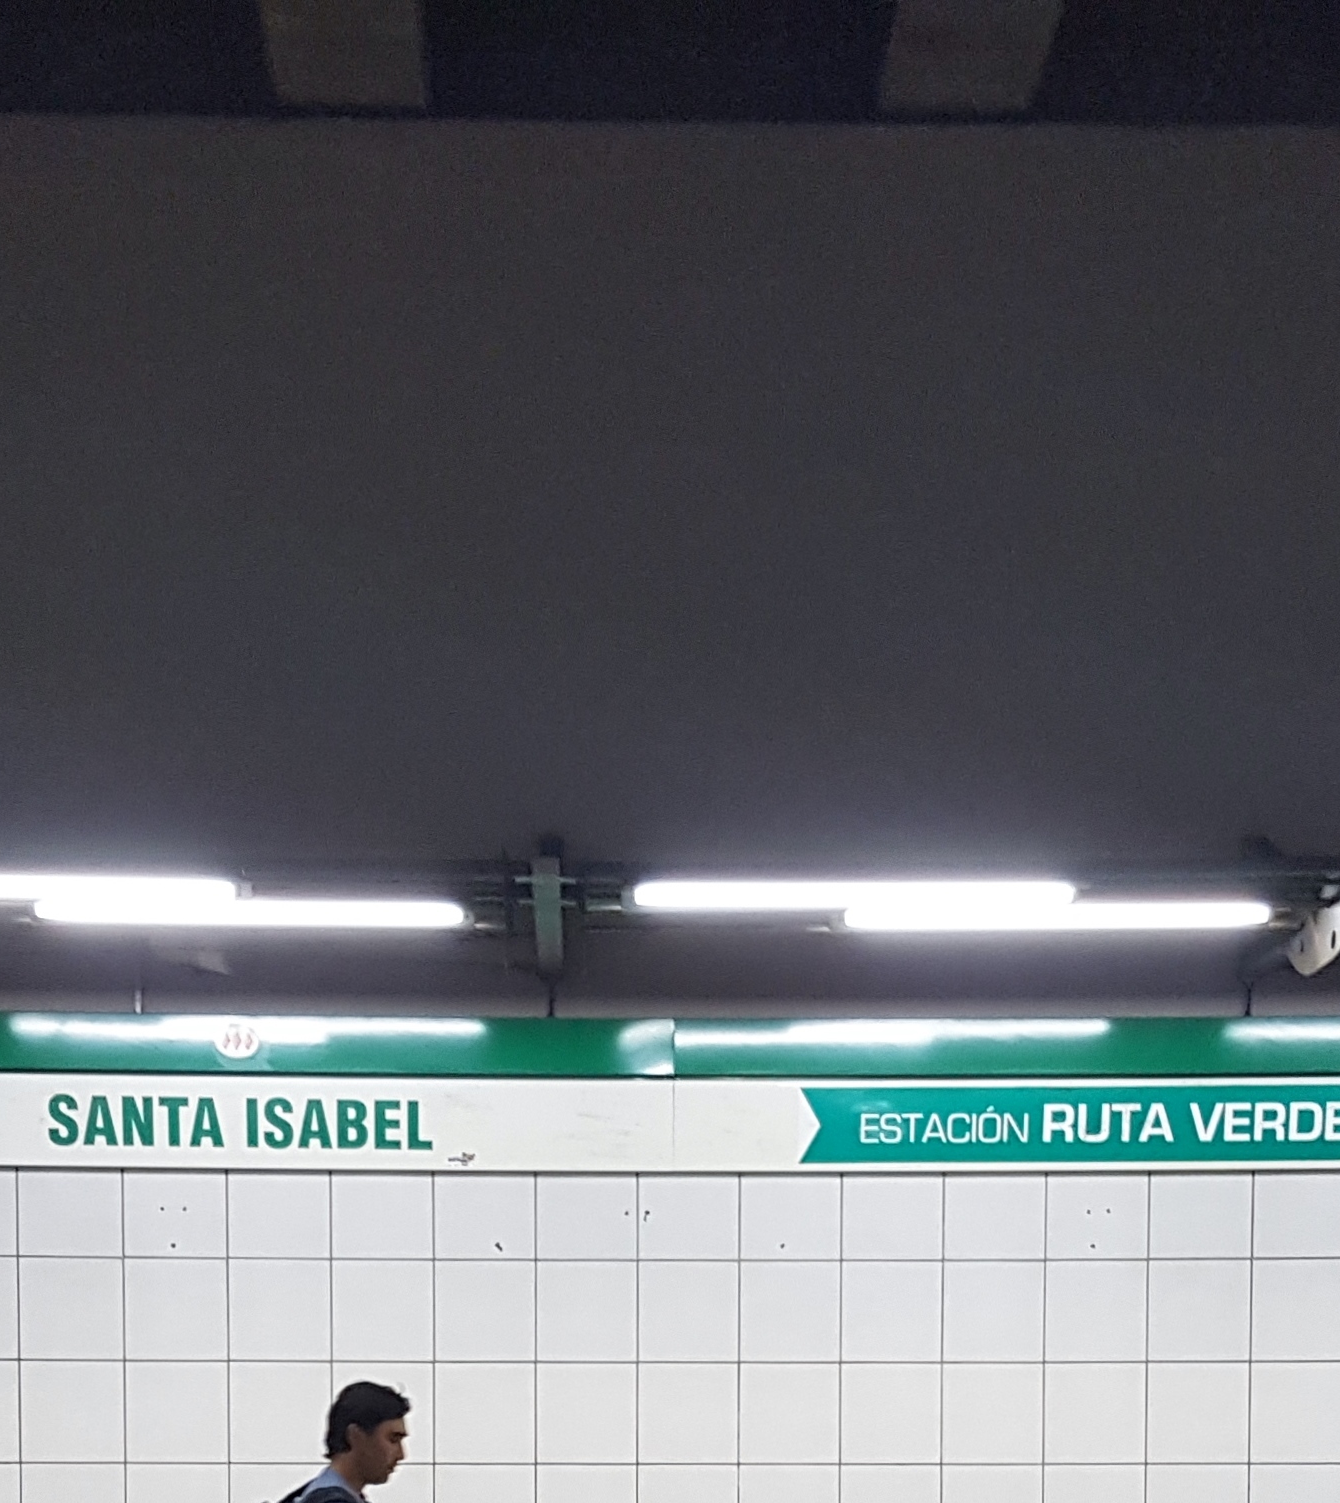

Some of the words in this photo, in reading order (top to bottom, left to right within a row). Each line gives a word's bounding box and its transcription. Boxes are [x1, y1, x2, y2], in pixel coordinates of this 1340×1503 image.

[48, 1095, 224, 1147] SANTA
[246, 1097, 433, 1150] ISABEL
[859, 1105, 1030, 1145] ESTACIÓN
[1041, 1102, 1174, 1144] RUTA
